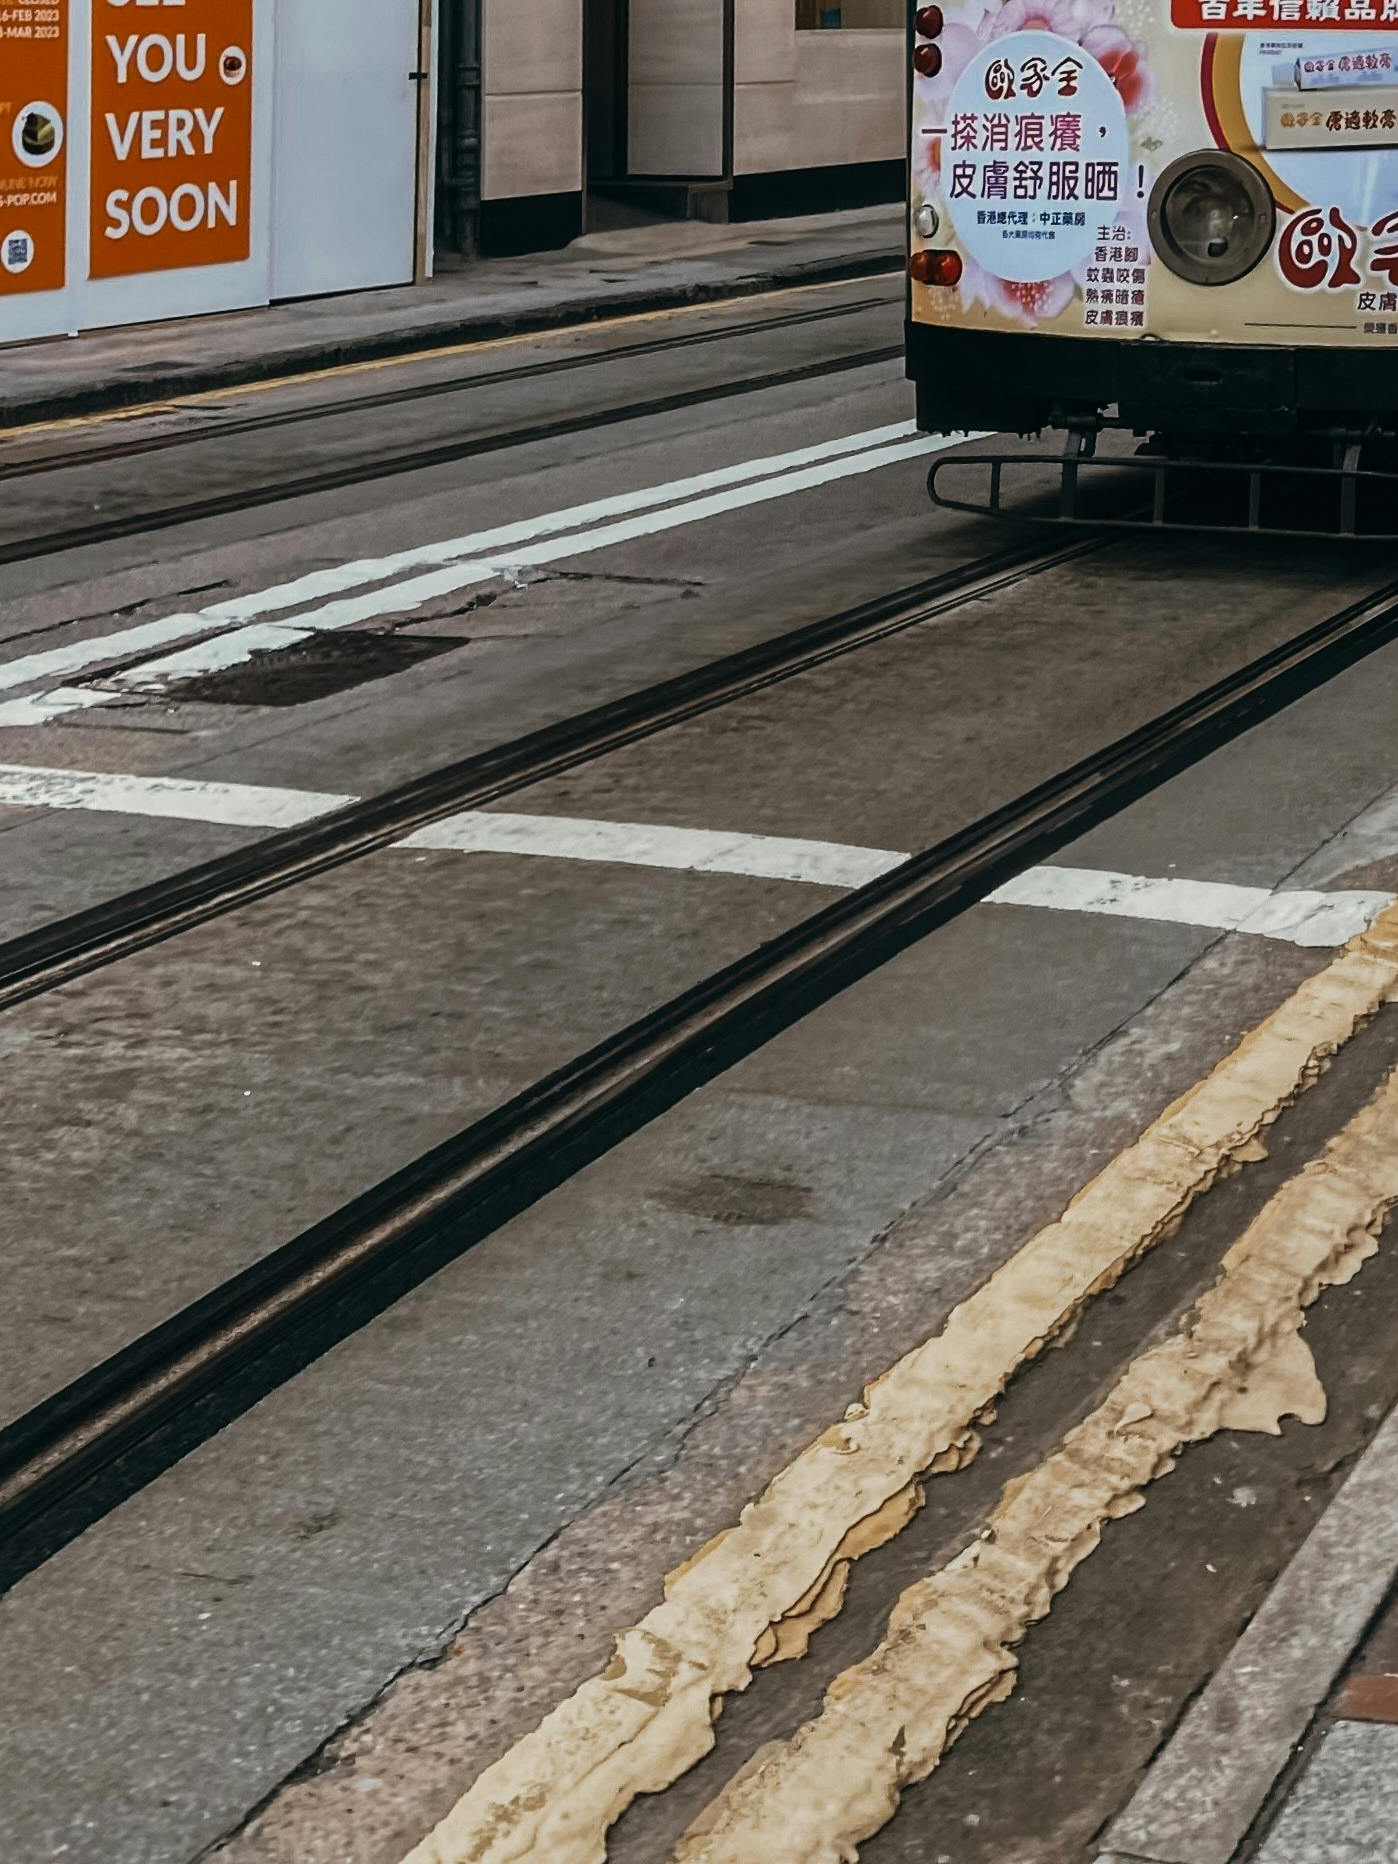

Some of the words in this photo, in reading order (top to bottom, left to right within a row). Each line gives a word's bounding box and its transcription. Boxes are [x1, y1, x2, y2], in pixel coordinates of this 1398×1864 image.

[105, 33, 206, 83] YOU
[104, 107, 224, 161] VERY
[104, 180, 237, 239] SOON
